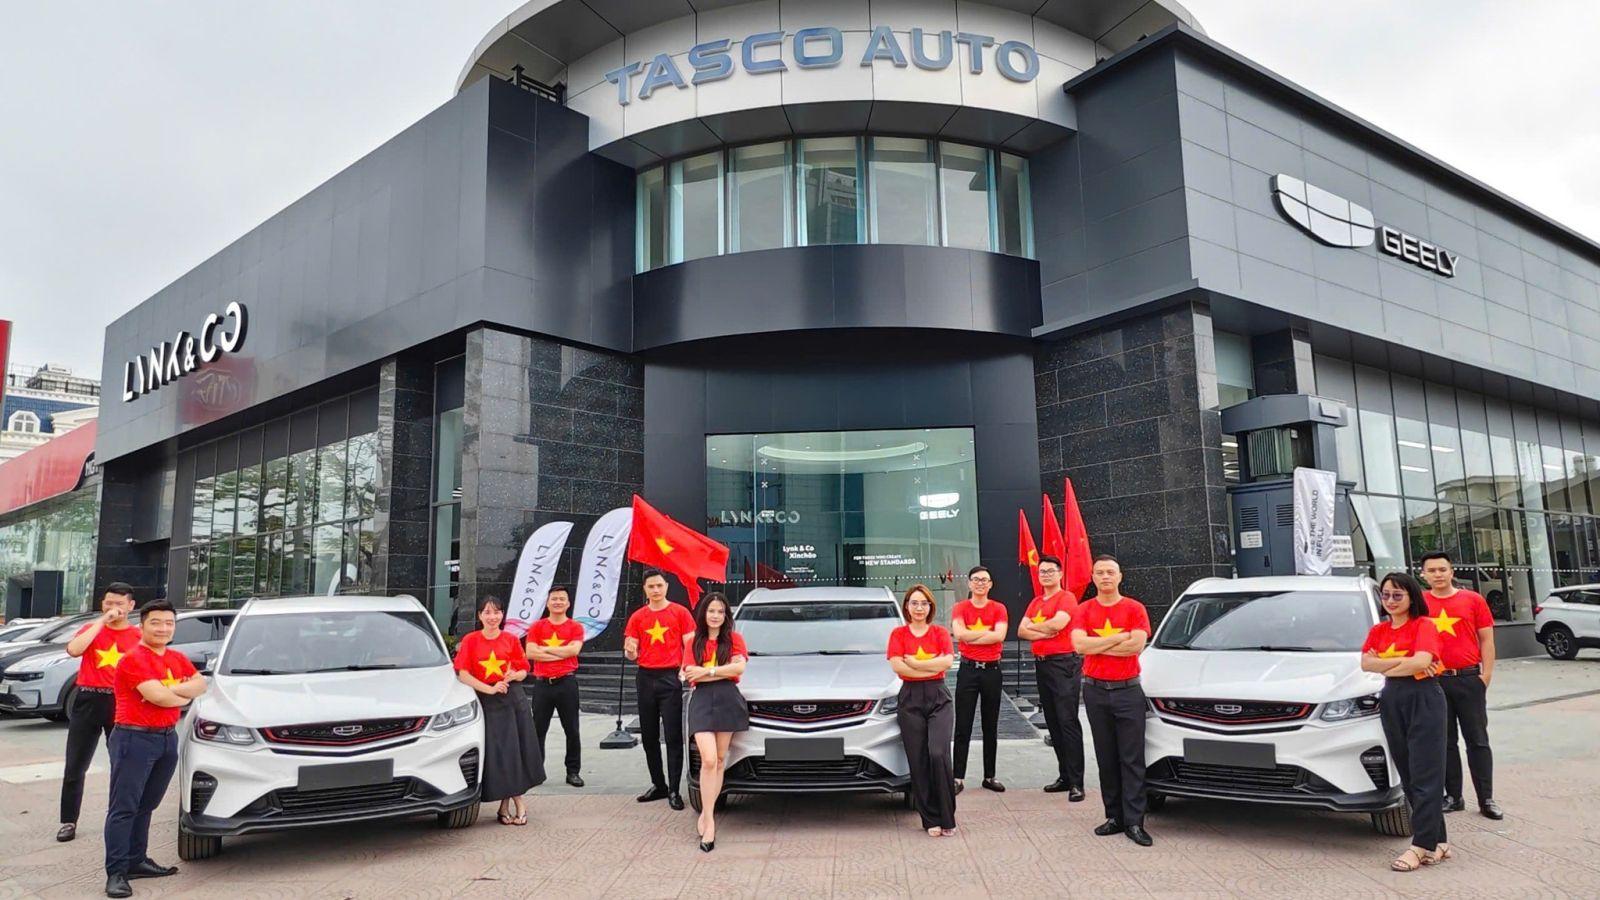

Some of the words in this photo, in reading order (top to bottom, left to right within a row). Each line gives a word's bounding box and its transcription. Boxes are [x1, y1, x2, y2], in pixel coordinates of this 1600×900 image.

[605, 27, 844, 106] TASCO
[860, 25, 1040, 83] AUTO
[1377, 225, 1459, 277] GEELY
[919, 509, 960, 520] GEELY
[880, 558, 916, 566] STANDARDS
